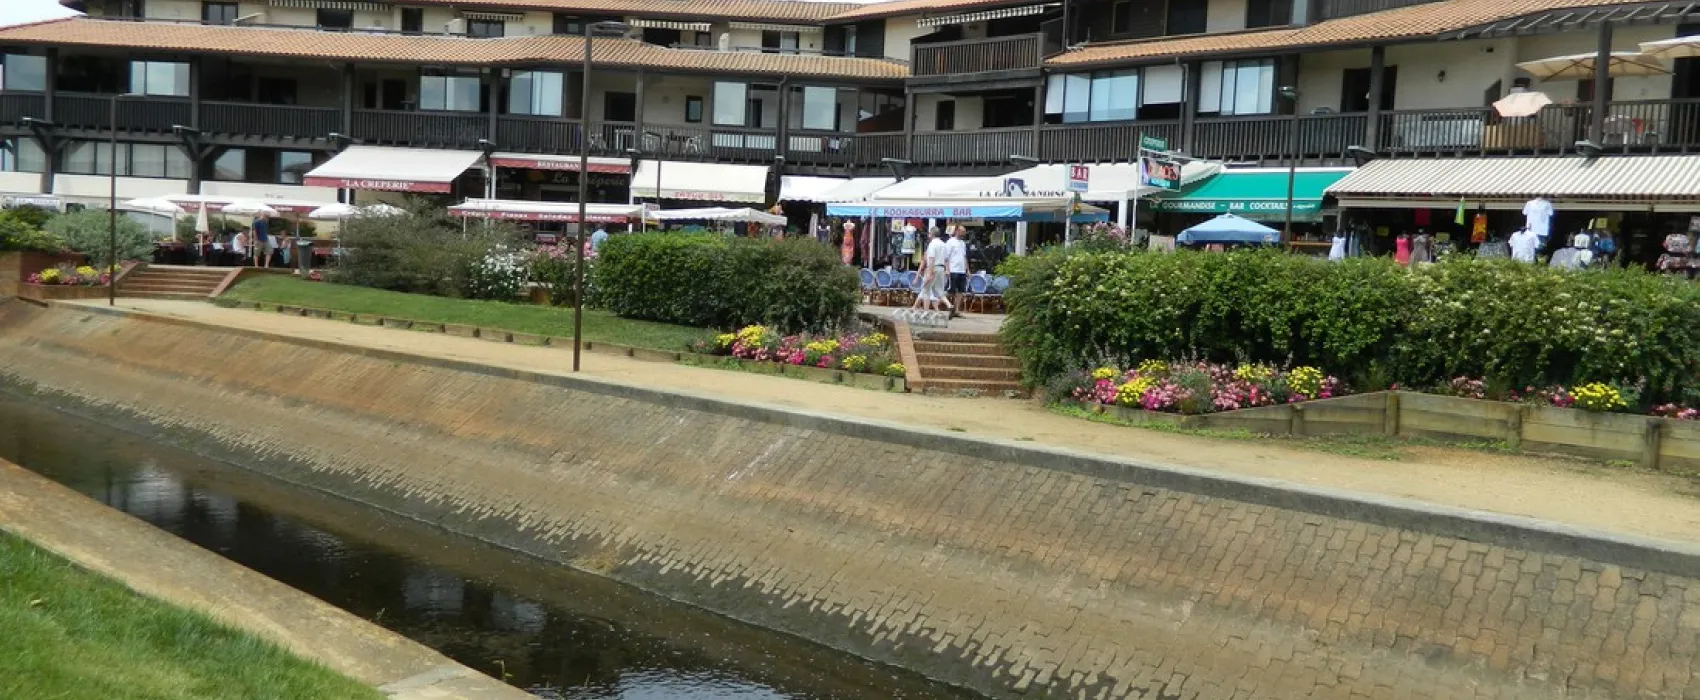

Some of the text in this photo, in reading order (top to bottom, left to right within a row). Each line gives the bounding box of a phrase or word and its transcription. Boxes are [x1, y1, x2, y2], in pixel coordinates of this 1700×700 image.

[537, 161, 581, 169] RESTAURAN
[1071, 166, 1088, 180] BAR
[1162, 202, 1216, 210] GOURMANDISE
[1229, 202, 1245, 210] BAR
[868, 208, 972, 216] LE KOOKABURRA BAR
